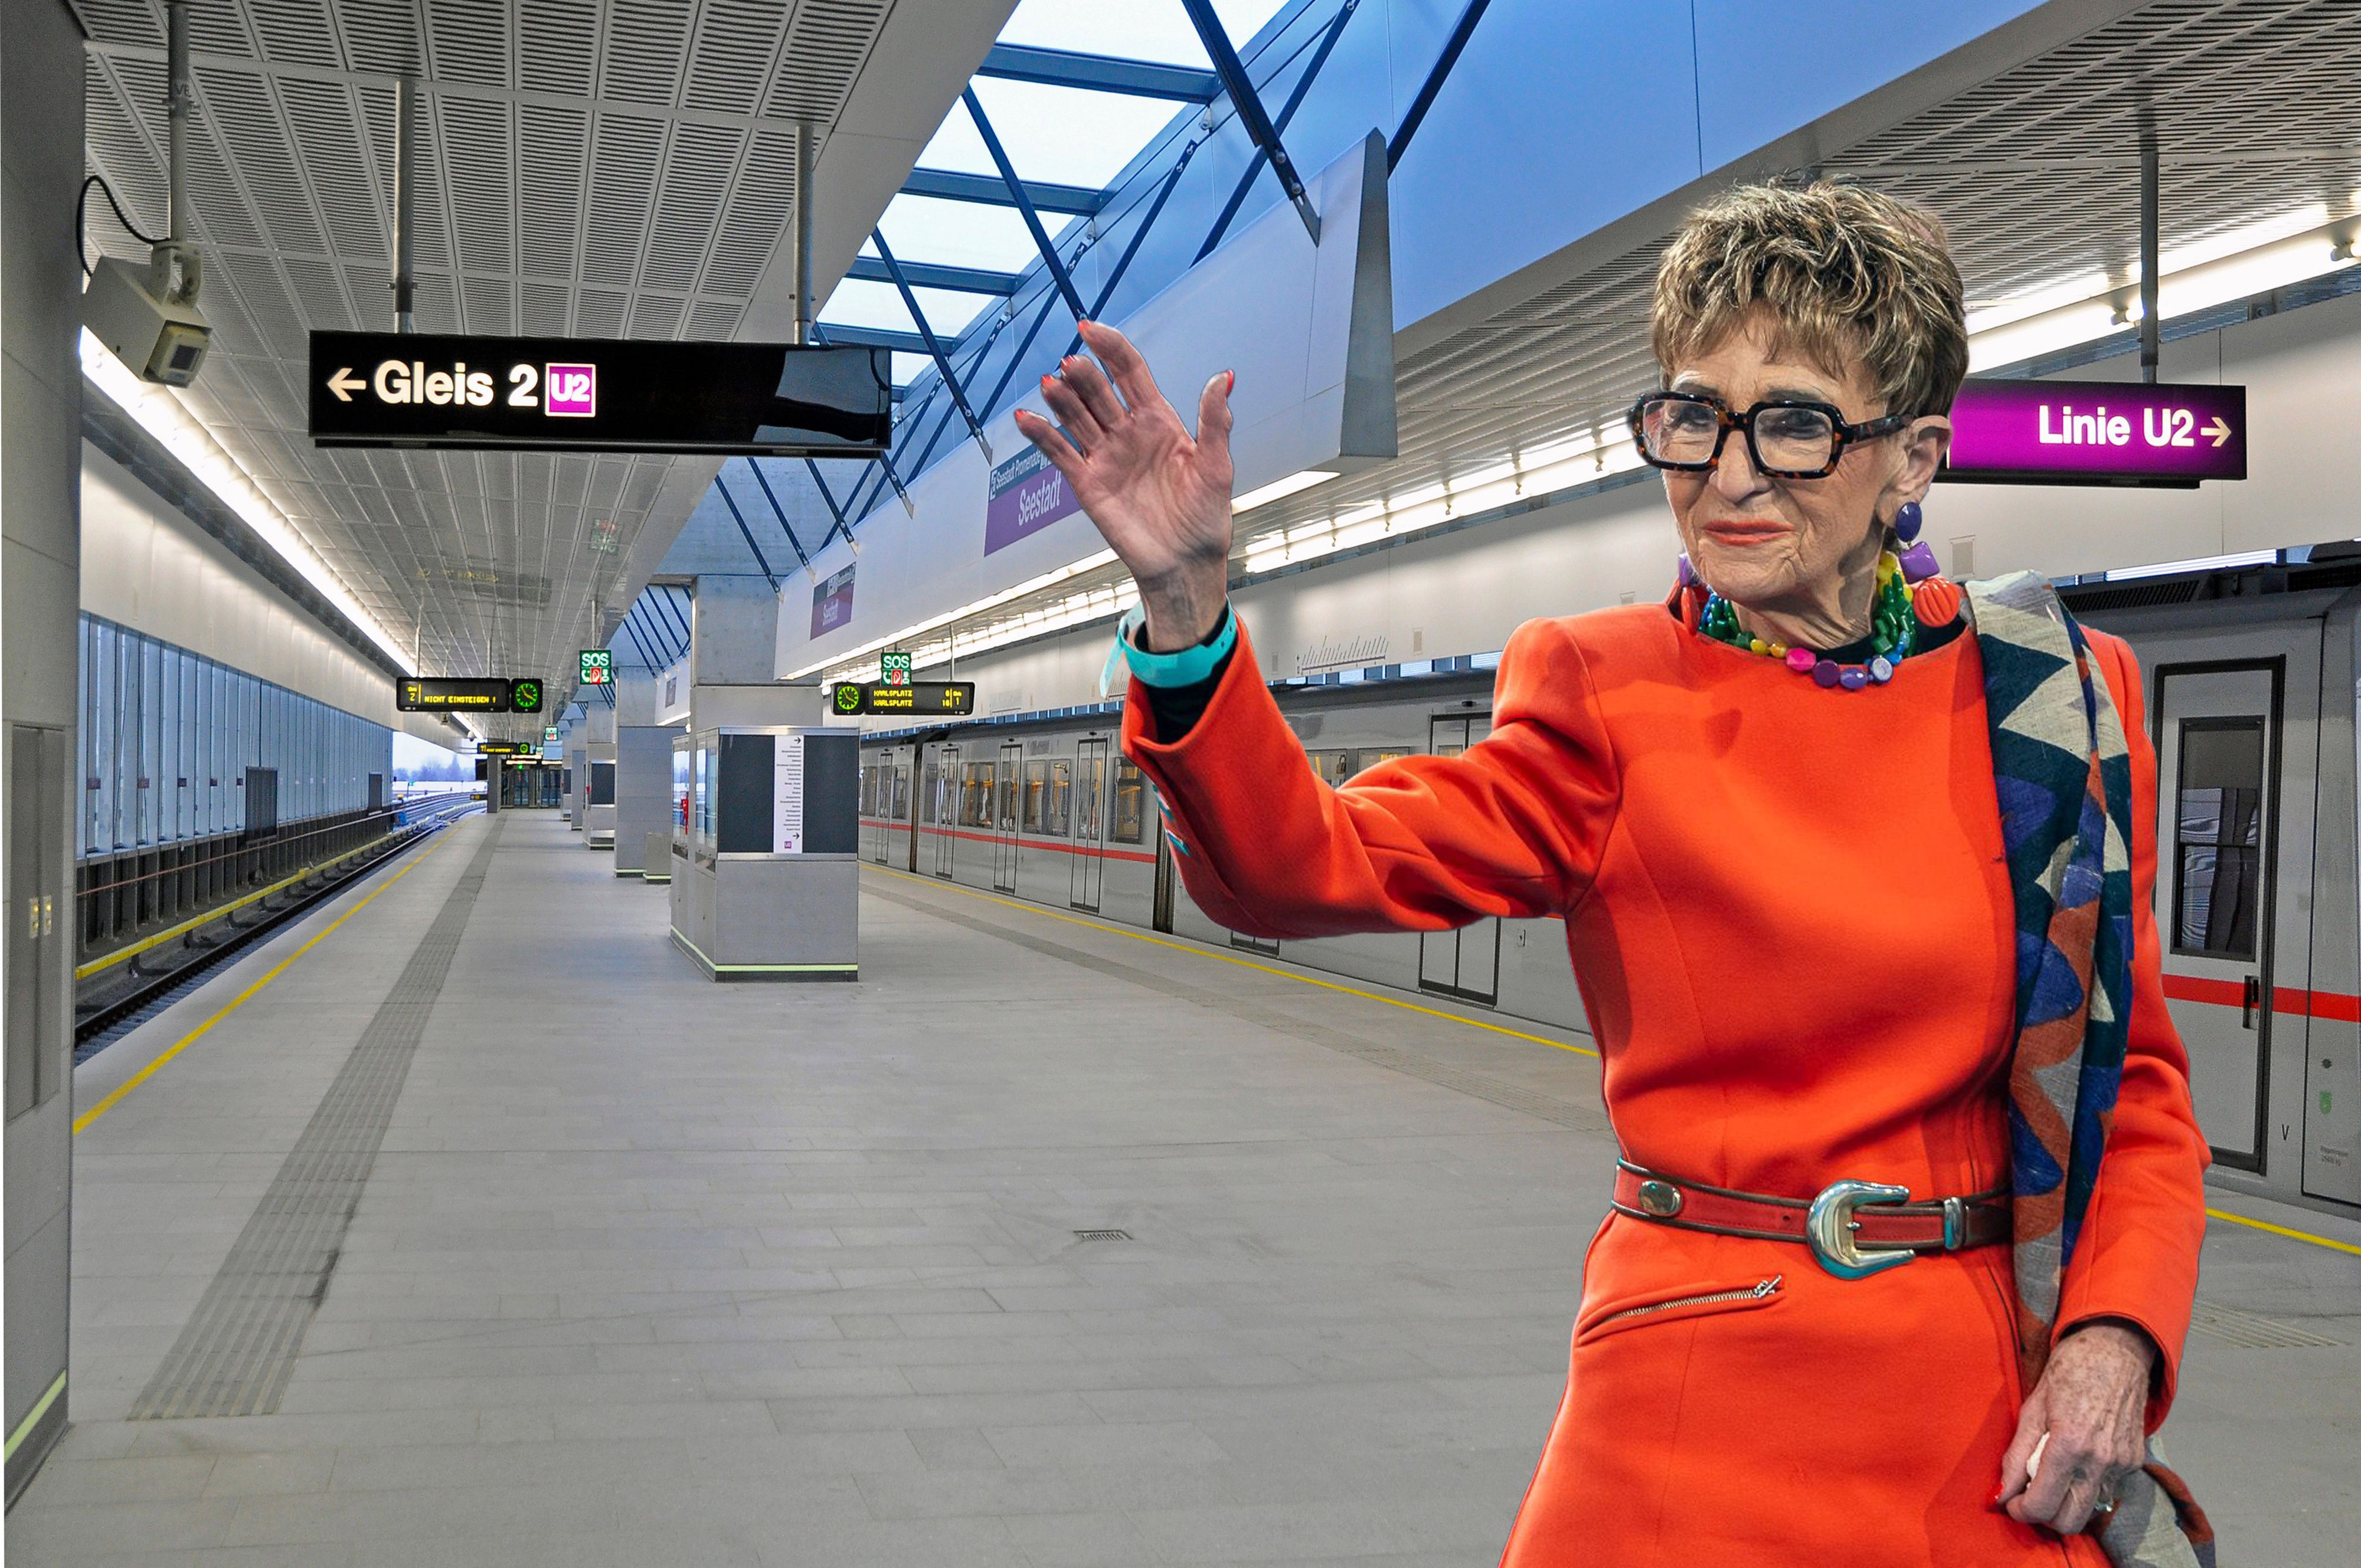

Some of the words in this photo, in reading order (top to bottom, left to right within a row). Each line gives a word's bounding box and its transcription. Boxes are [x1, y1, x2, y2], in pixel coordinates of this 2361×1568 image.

[375, 359, 494, 407] Gleis
[508, 364, 538, 407] 2
[551, 373, 590, 402] U2
[2039, 405, 2130, 446] Linie
[2144, 408, 2194, 447] U2
[996, 462, 1015, 489] Seestadt
[1018, 470, 1061, 526] Seestadt
[581, 653, 609, 667] SOS
[883, 655, 910, 669] SOS
[410, 693, 416, 702] 2
[424, 695, 446, 703] NICHT
[447, 695, 489, 704] EINSTEIGEN
[956, 697, 959, 705] 1
